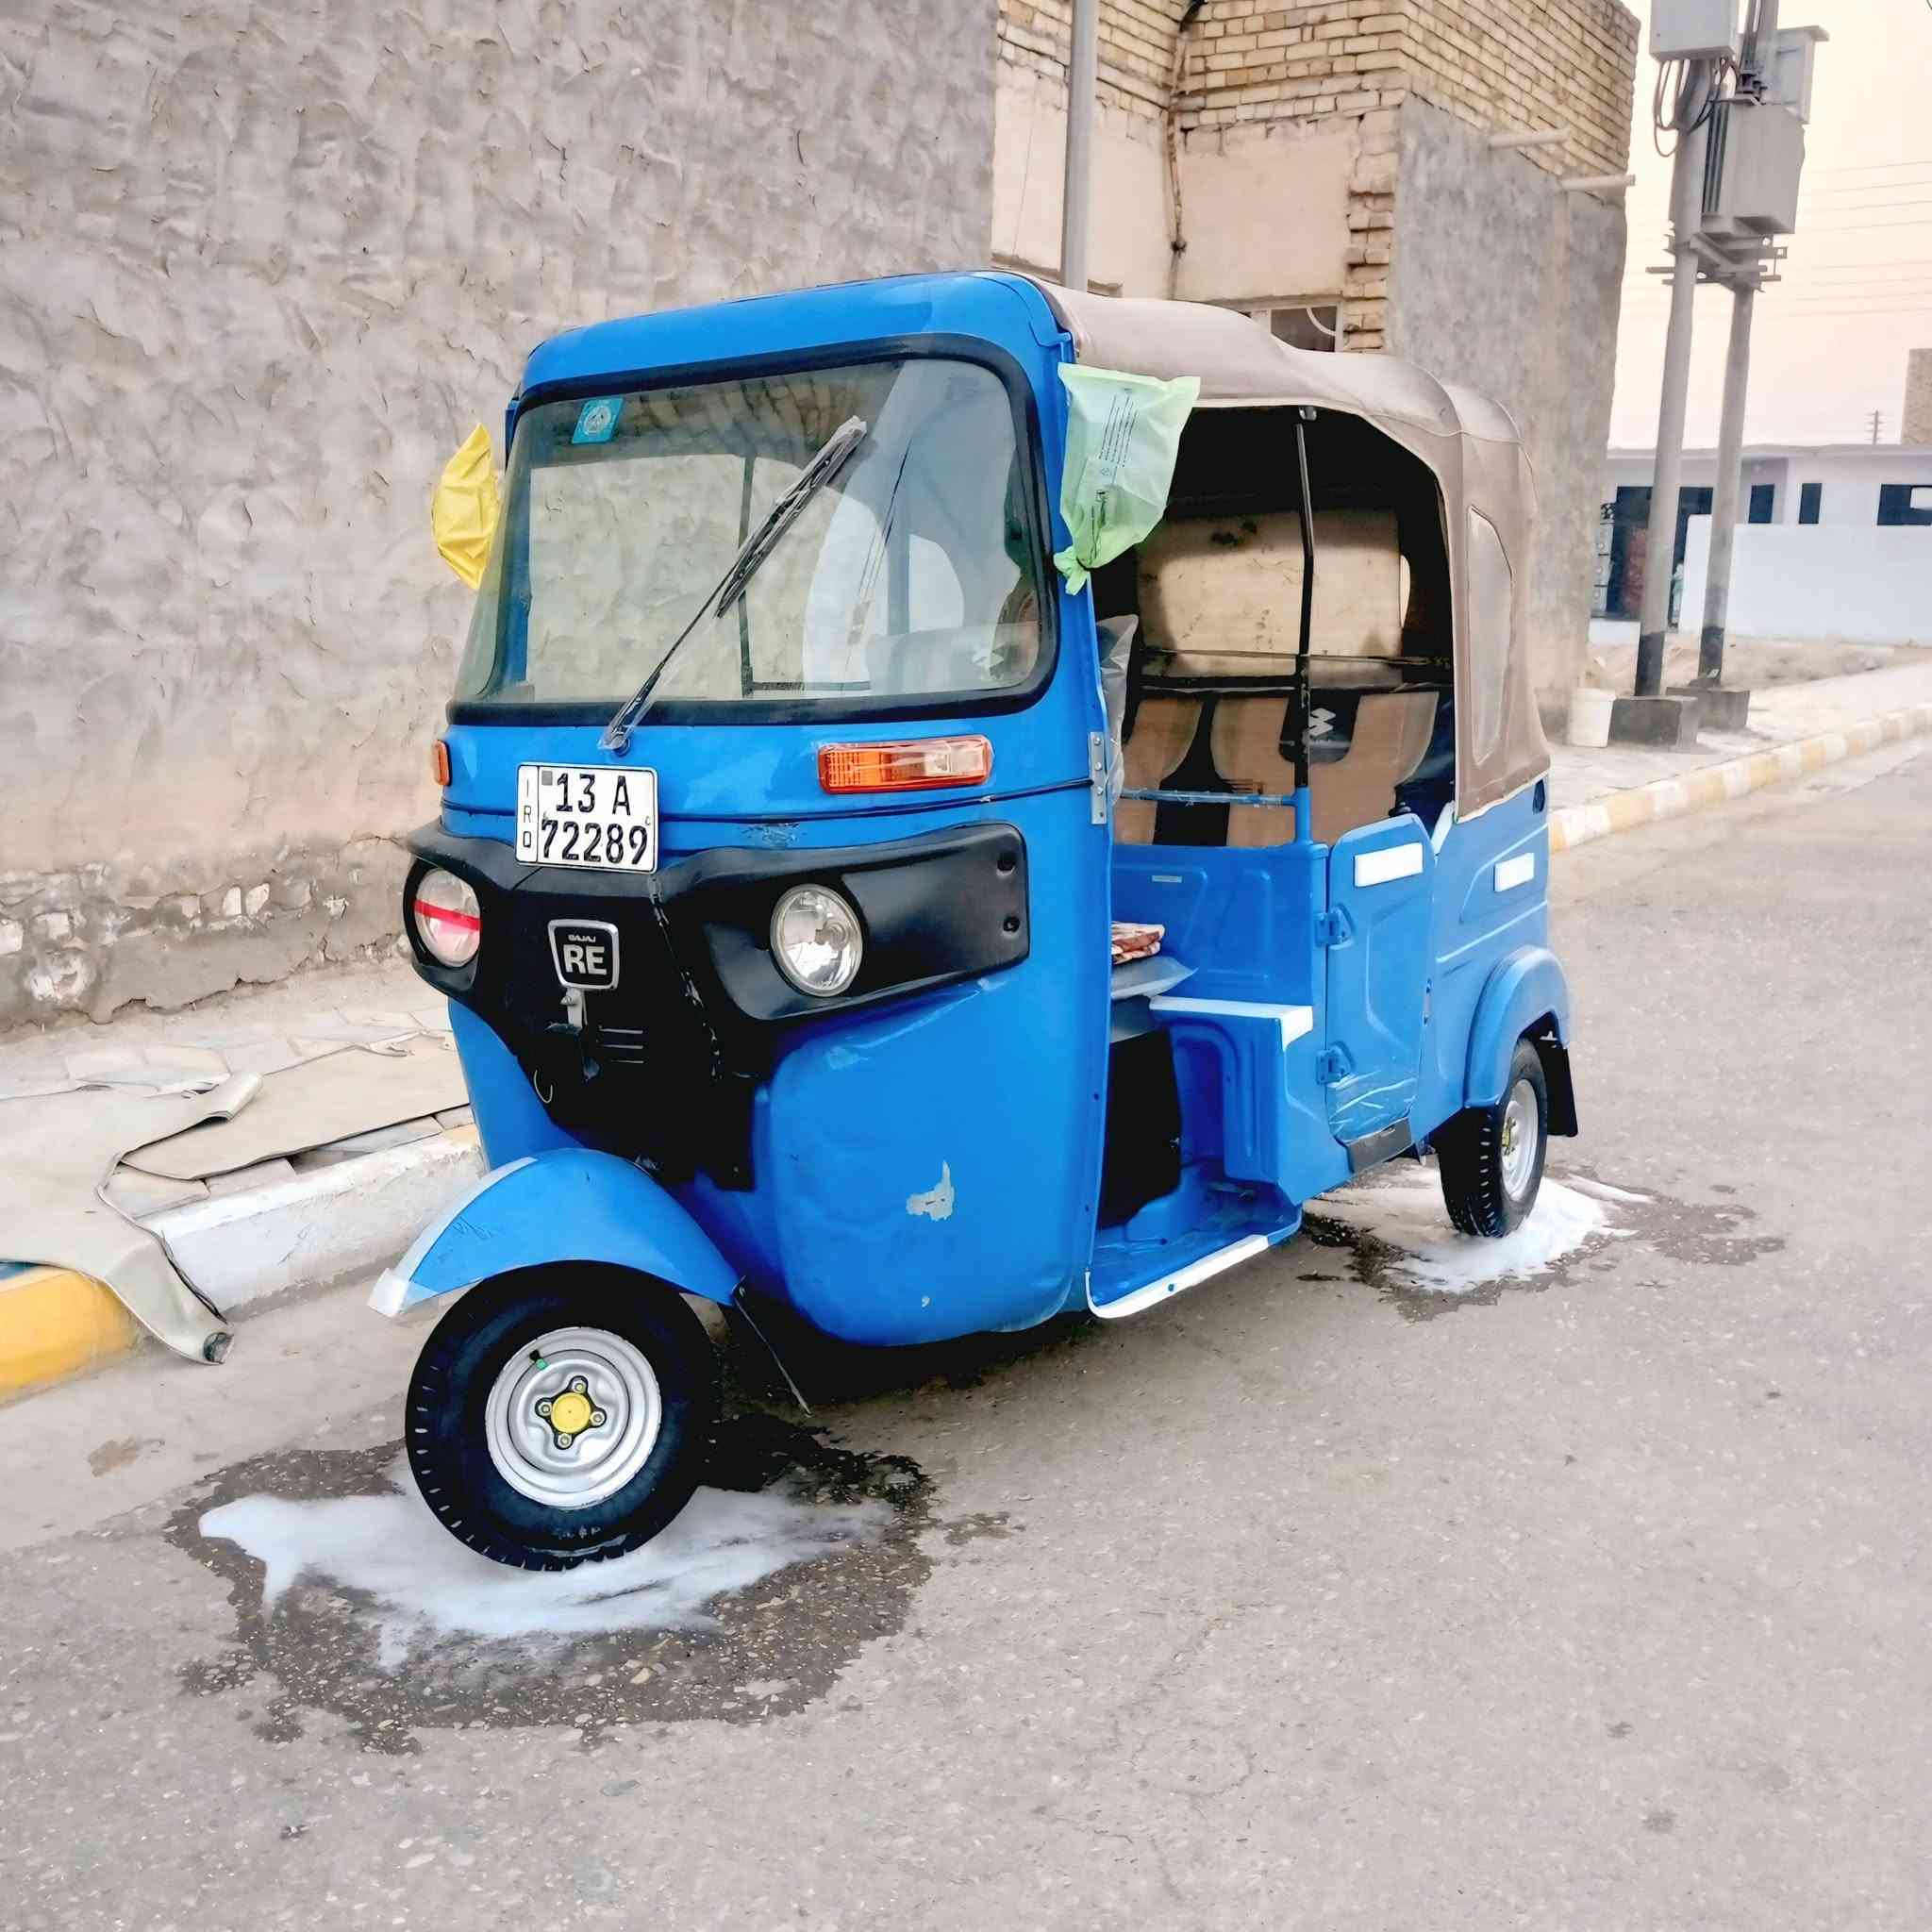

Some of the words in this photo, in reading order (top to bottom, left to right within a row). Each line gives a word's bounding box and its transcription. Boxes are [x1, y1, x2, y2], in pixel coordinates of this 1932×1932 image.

[556, 773, 596, 813] 13
[612, 774, 631, 816] A
[541, 819, 648, 865] 72289
[563, 944, 607, 975] RE
